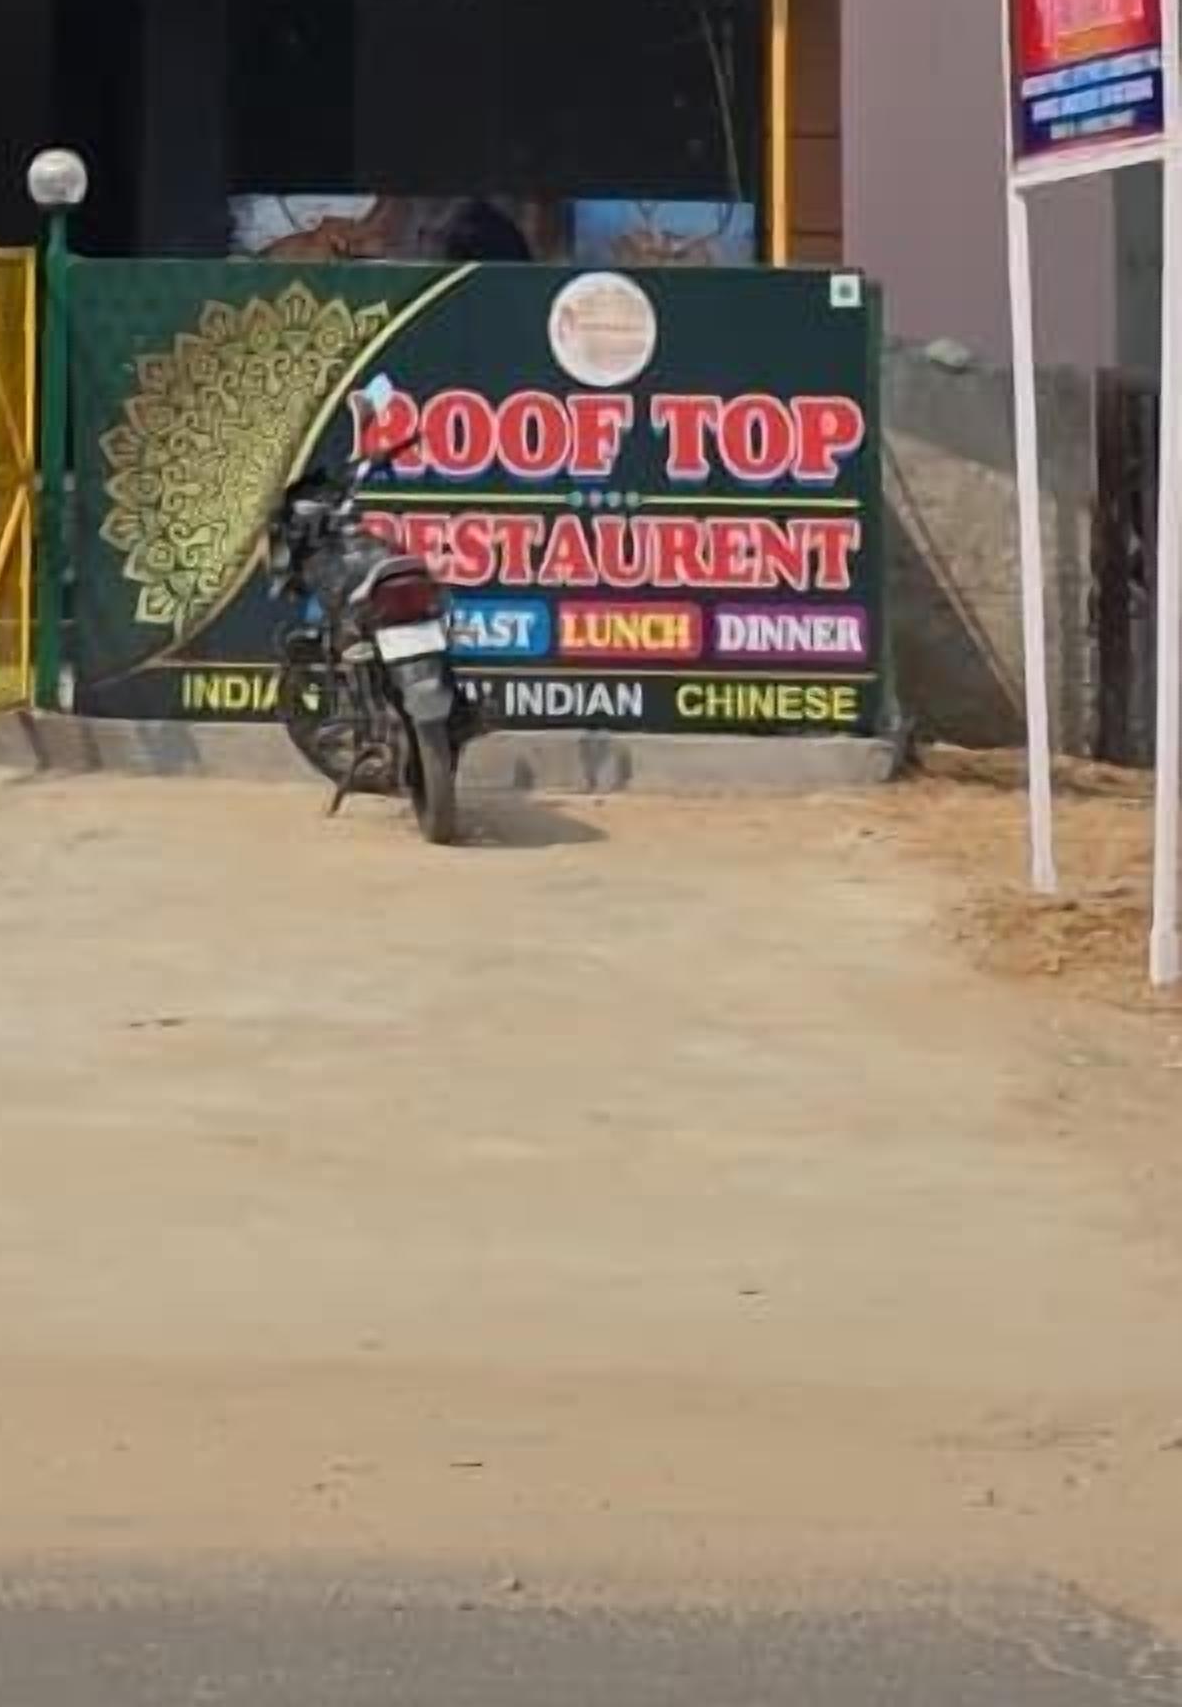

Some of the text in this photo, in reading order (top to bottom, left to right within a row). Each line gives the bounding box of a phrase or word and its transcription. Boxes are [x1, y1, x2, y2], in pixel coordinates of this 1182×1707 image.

[348, 390, 865, 483] ROOF TOP
[561, 611, 691, 651] LUNCH
[716, 612, 864, 654] DINNER
[505, 680, 644, 718] INDIAN
[676, 682, 859, 723] CHINESE
